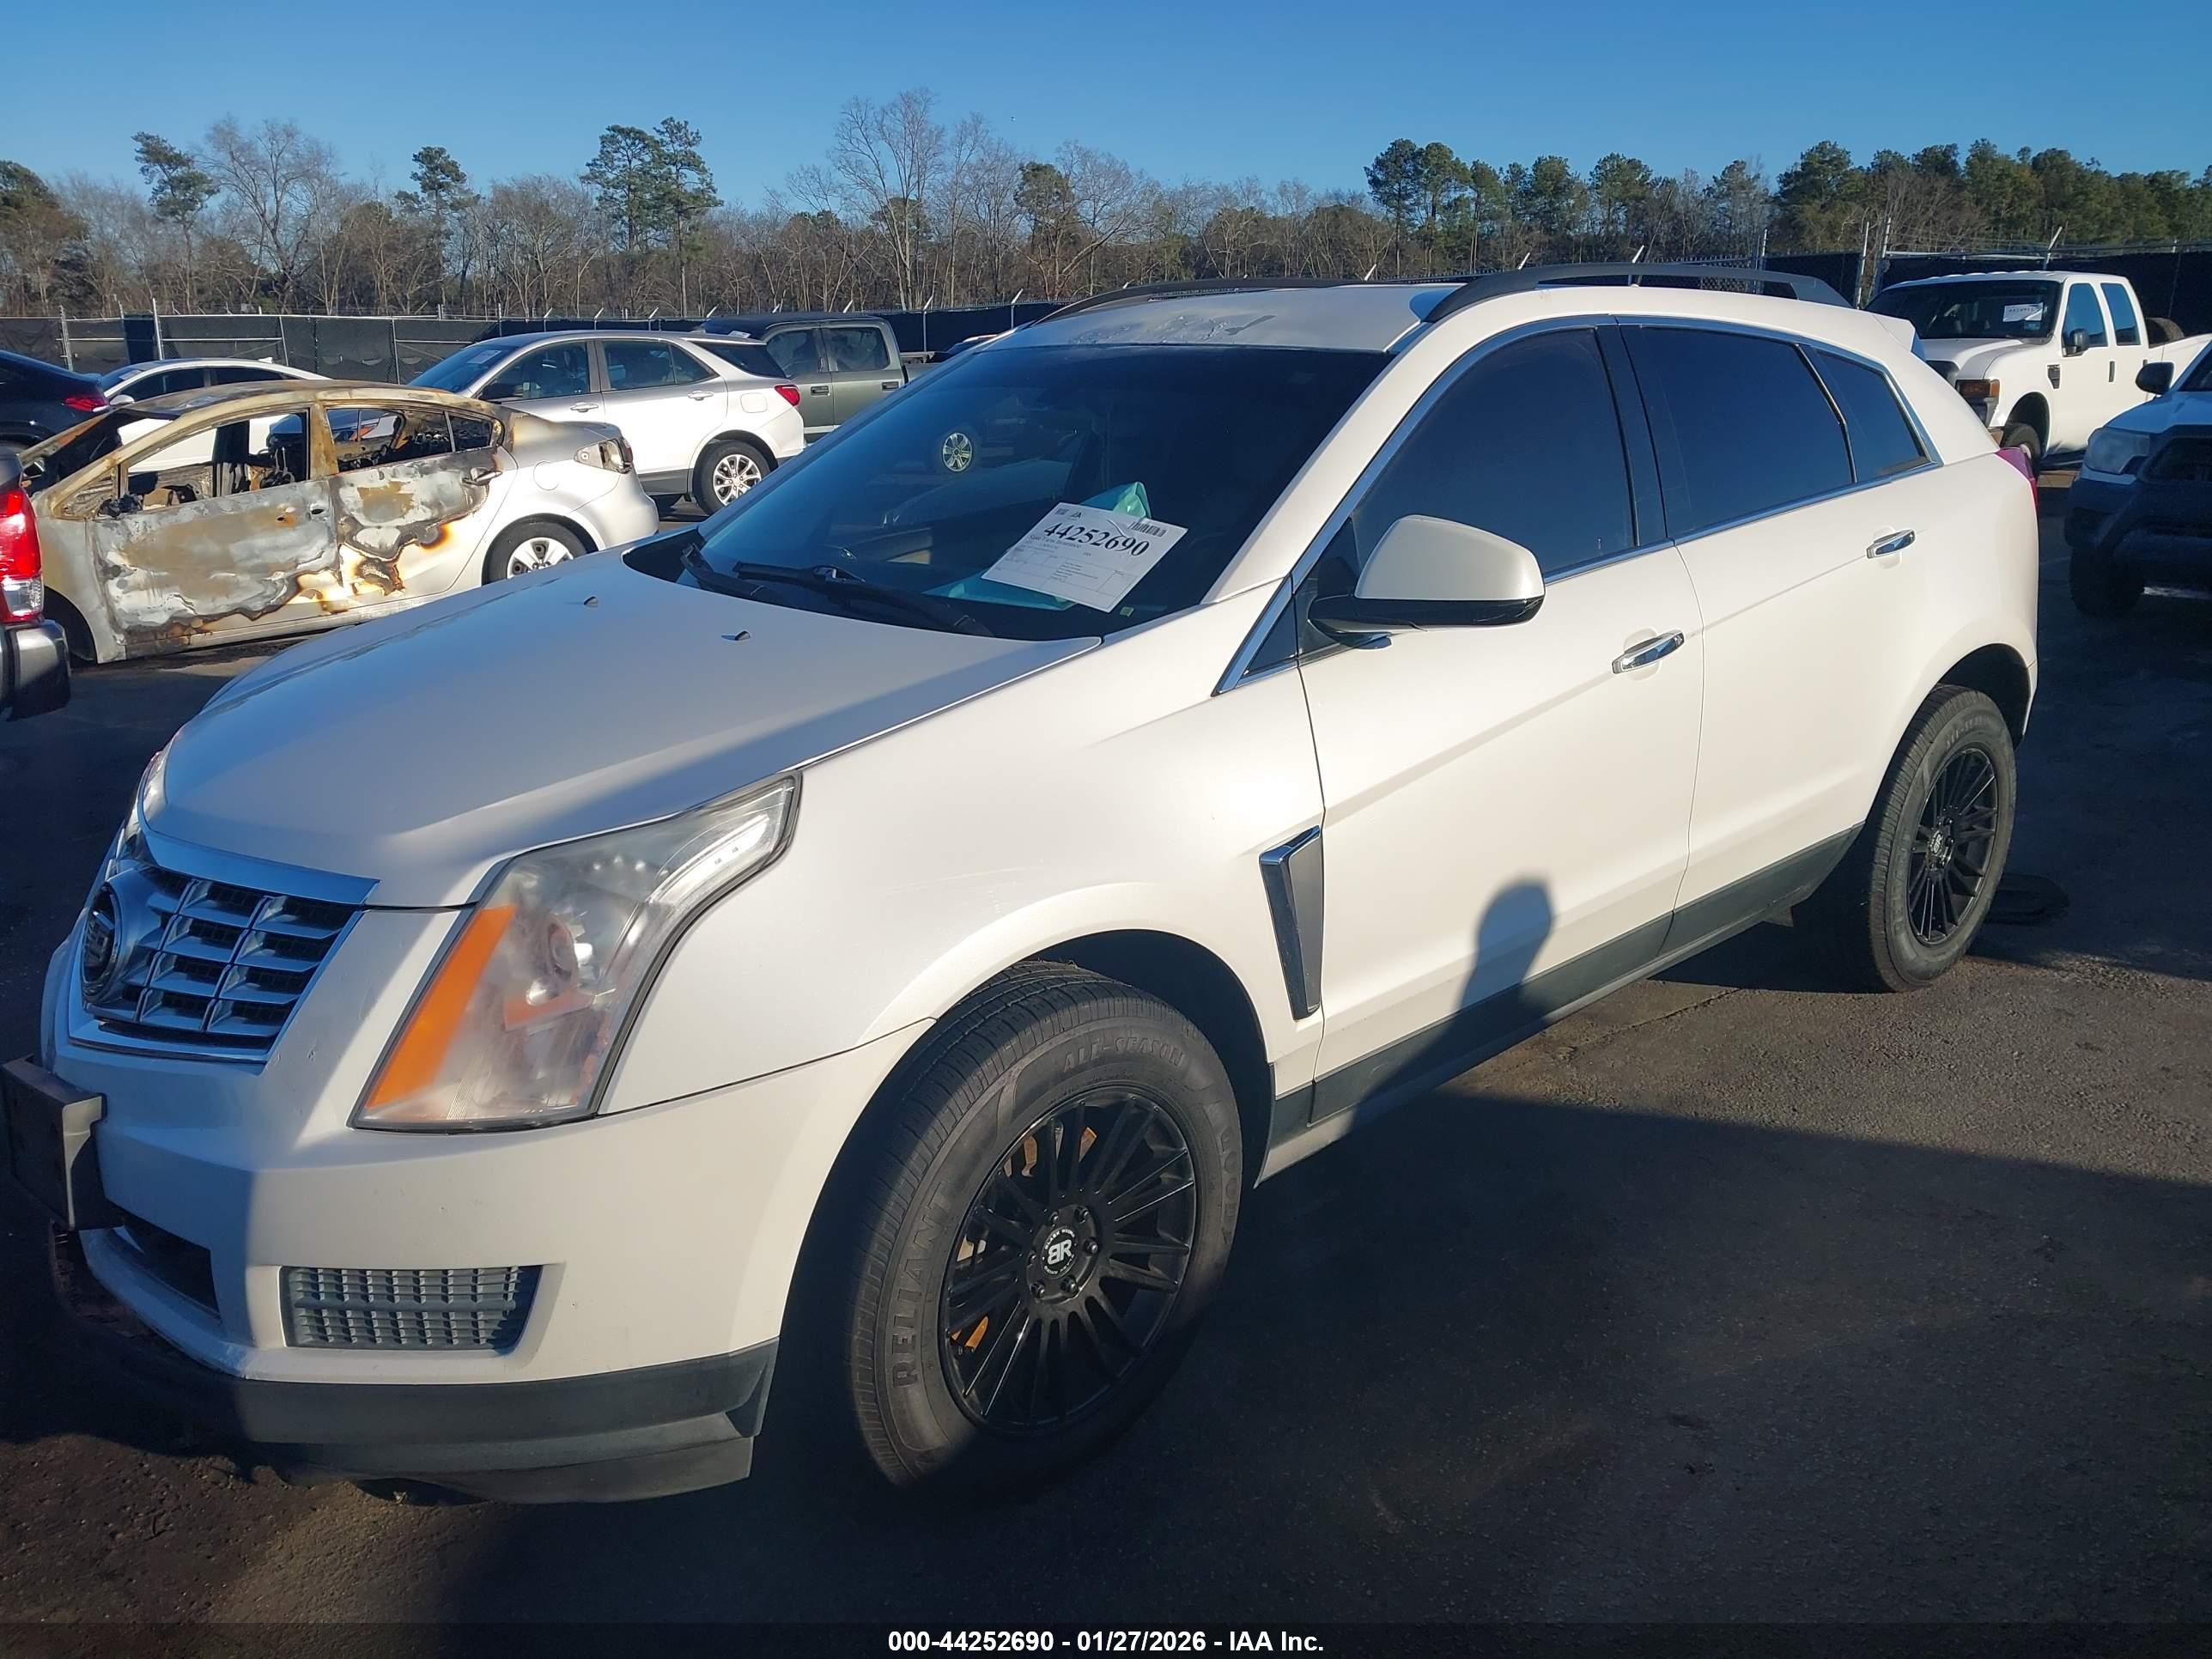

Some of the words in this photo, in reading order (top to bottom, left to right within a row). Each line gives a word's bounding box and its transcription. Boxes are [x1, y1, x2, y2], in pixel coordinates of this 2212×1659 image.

[1044, 522, 1150, 556] 44252690
[1063, 1036, 1186, 1073] ALL-SEASON
[891, 1180, 957, 1389] RELIANT
